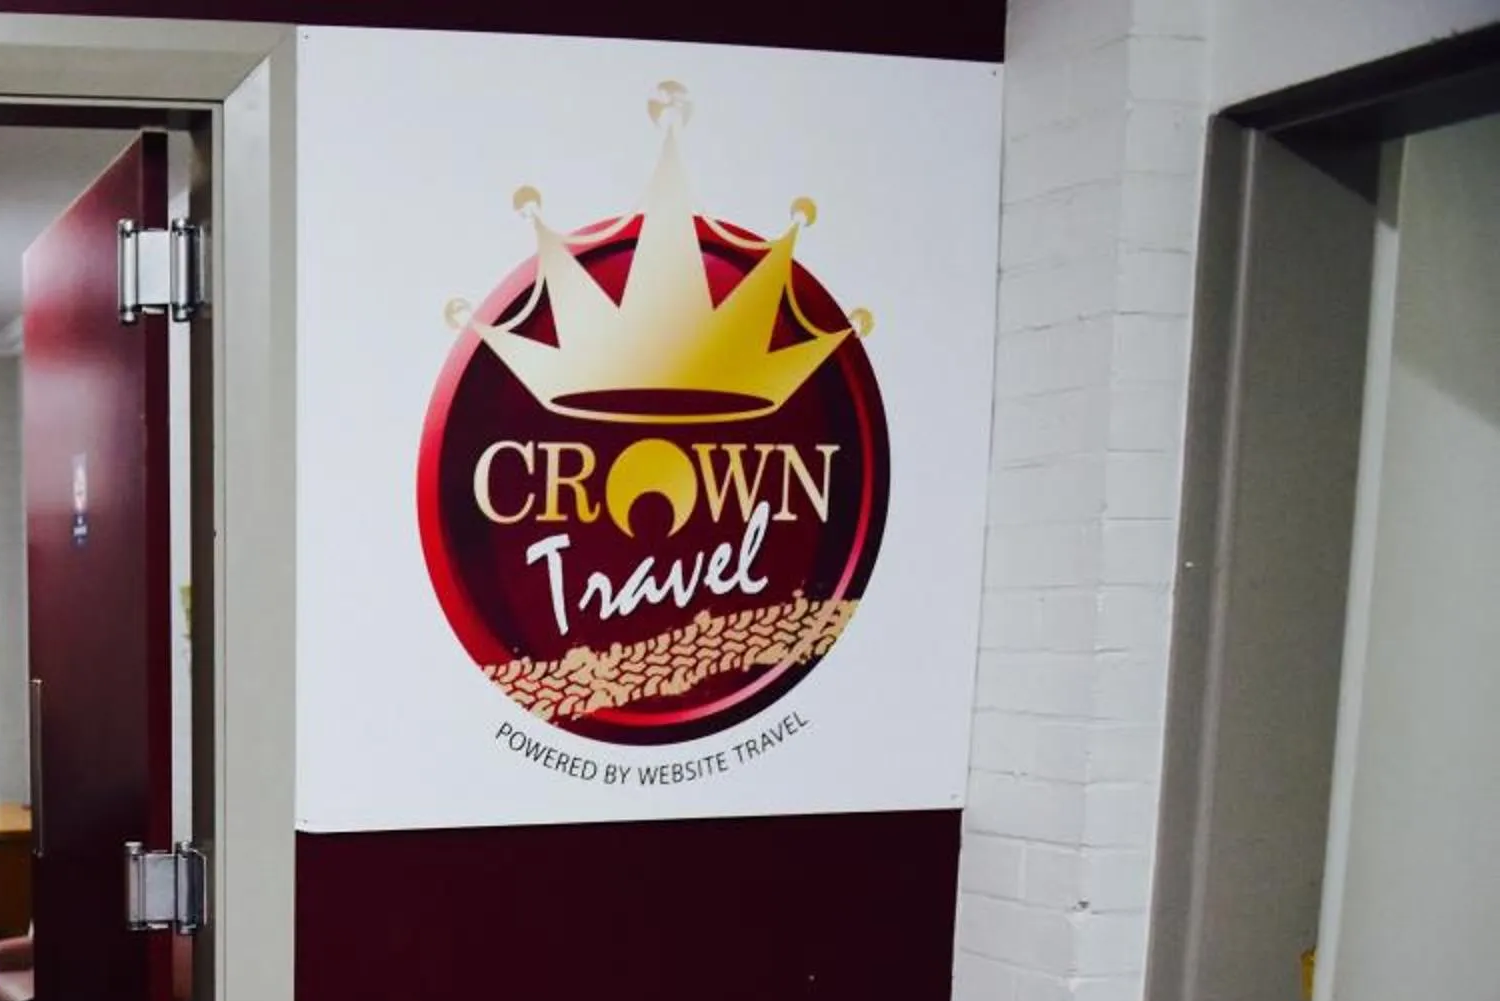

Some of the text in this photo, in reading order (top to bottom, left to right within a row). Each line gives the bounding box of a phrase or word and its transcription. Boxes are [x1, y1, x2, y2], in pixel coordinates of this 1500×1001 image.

[473, 438, 841, 539] CROWN
[525, 501, 771, 636] Travel
[495, 711, 810, 786] POWERED BY WEBSITE TRAVEL
